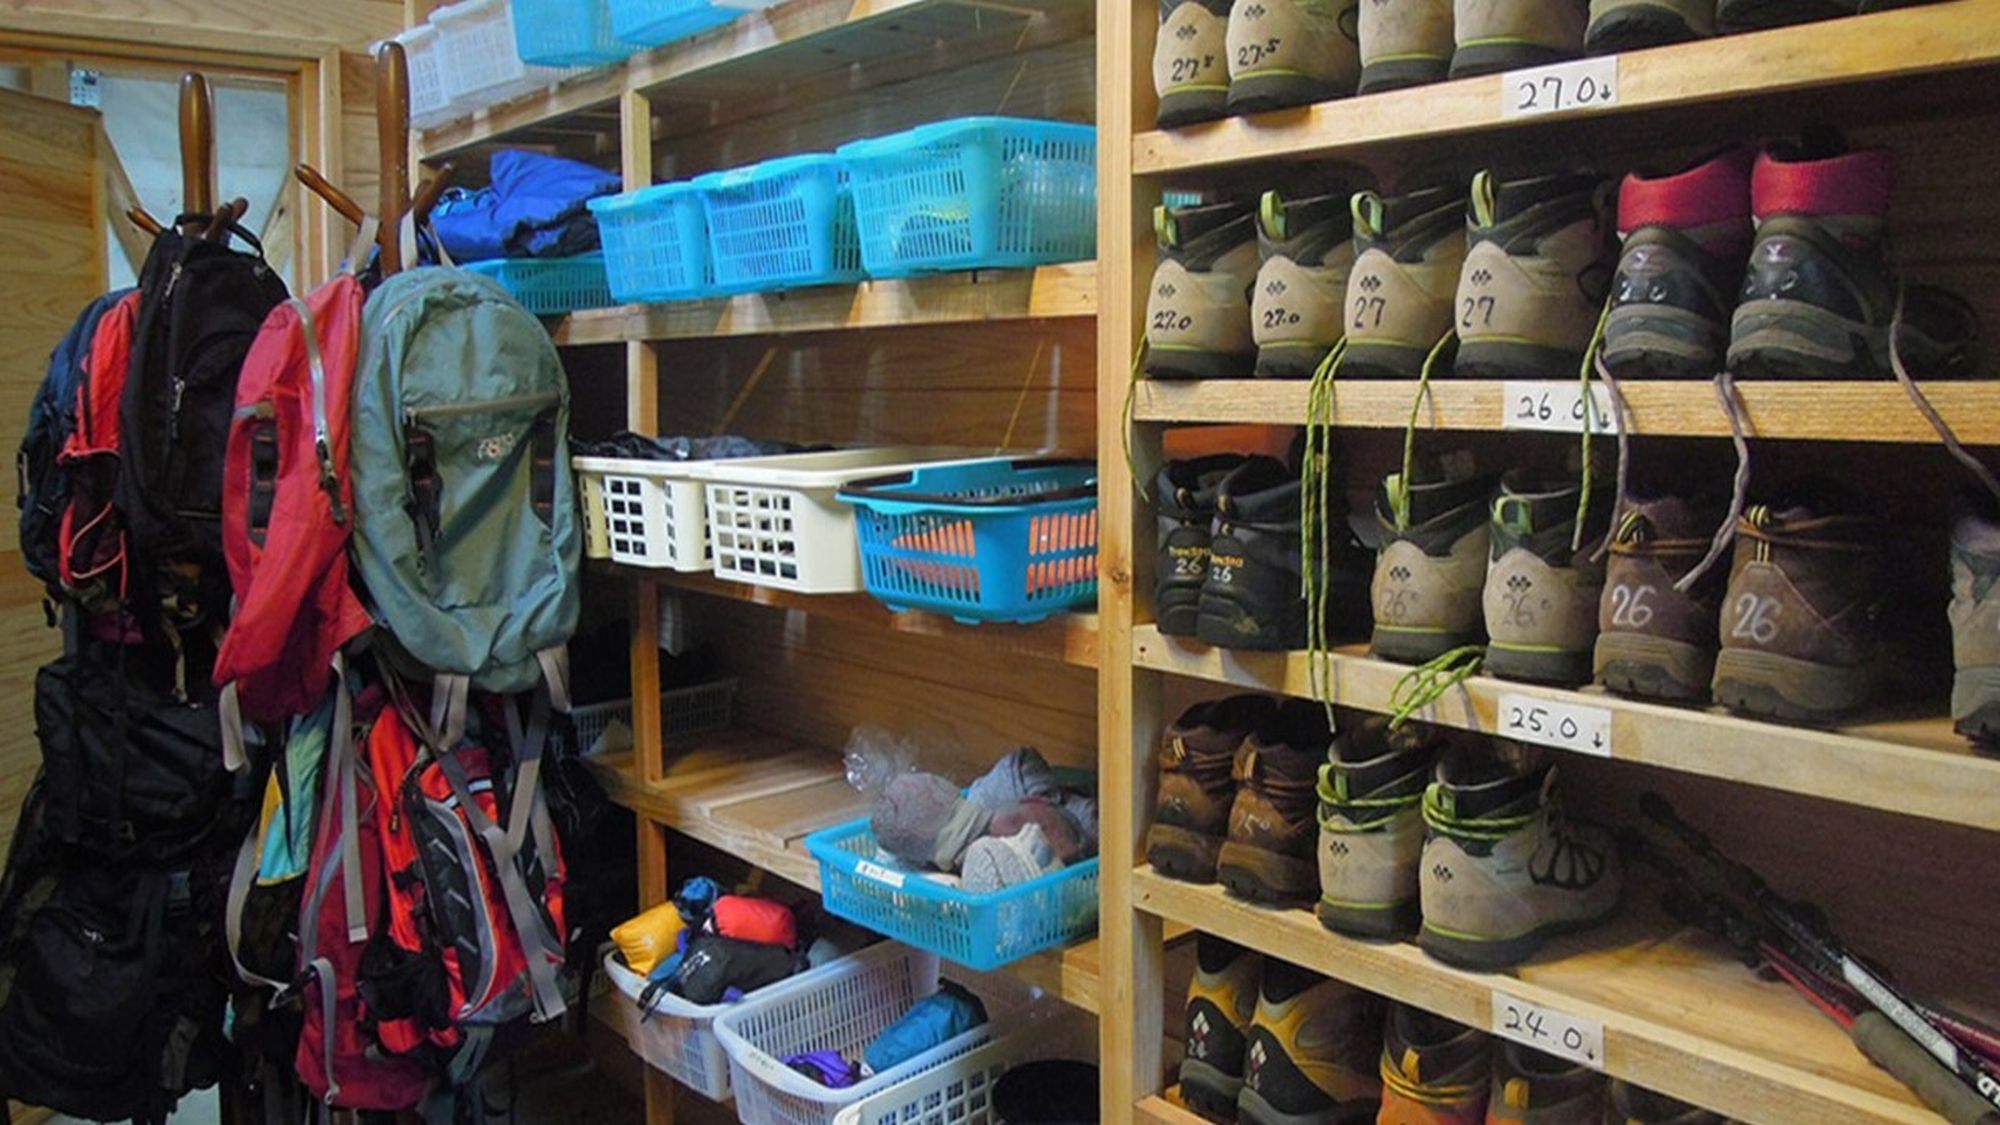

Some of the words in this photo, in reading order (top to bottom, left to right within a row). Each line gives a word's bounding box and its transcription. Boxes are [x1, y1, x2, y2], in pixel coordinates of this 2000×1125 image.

[1518, 76, 1596, 109] 27.0
[1354, 296, 1386, 328] 27
[1462, 296, 1495, 328] 27
[1212, 566, 1232, 583] 26
[1612, 585, 1656, 627] 26
[1732, 592, 1781, 644] 26
[1509, 707, 1577, 738] 25.0
[1505, 1006, 1581, 1049] 24.0
